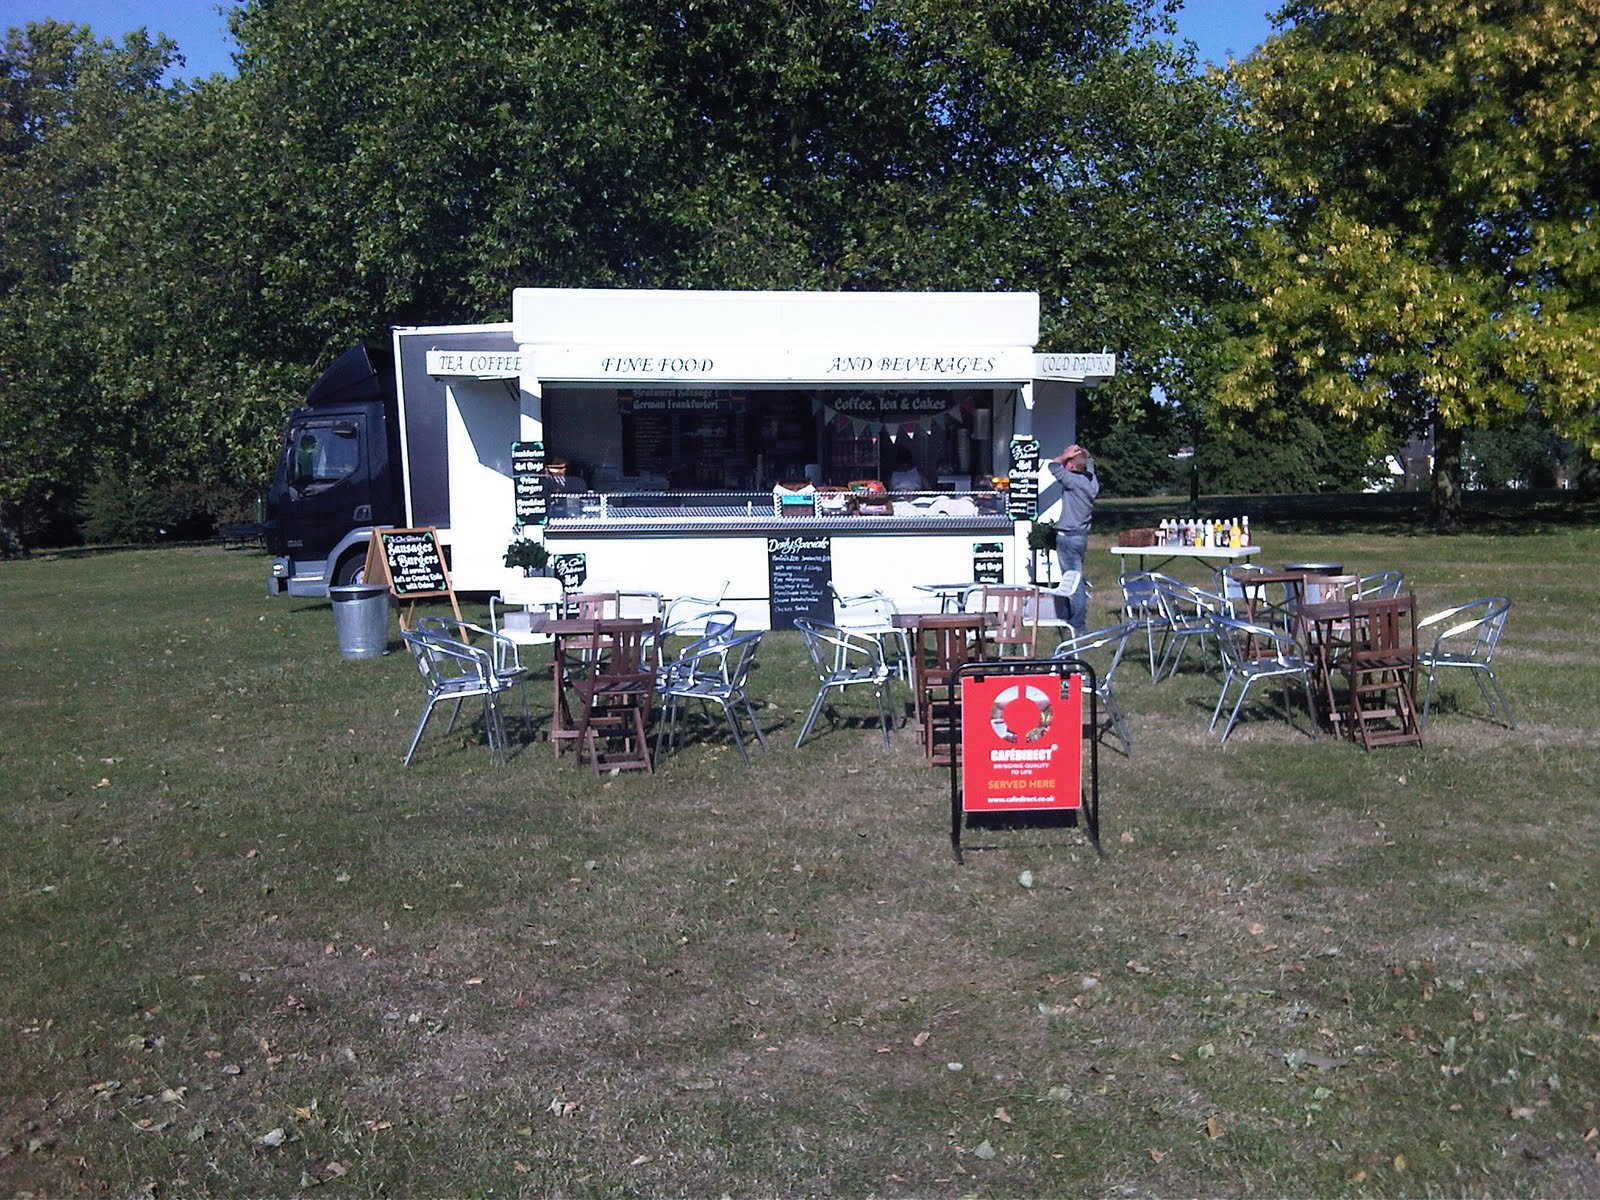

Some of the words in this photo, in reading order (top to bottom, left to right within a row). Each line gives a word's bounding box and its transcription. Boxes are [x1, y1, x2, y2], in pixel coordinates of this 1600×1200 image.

[440, 356, 463, 371] TEA
[470, 356, 522, 371] COFFEE
[601, 358, 653, 373] FINE
[657, 358, 714, 373] FOOD
[826, 357, 873, 373] AND
[877, 357, 996, 374] BEVERAGES
[1042, 355, 1070, 372] COLD
[1072, 356, 1112, 373] DRINKS
[633, 400, 666, 410] German
[880, 398, 897, 410] Tea
[900, 399, 910, 410] &
[912, 398, 945, 410] Cakes
[514, 462, 527, 471] Hot
[527, 462, 544, 472] Dogs
[1016, 460, 1032, 470] Hot
[517, 485, 543, 494] Burgers
[388, 543, 433, 556] Sausages
[768, 537, 792, 554] Daily
[791, 537, 830, 554] Specials
[389, 556, 397, 567] &
[397, 555, 439, 567] Burgers
[988, 780, 1027, 790] SERVED
[1029, 779, 1056, 788] HERE
